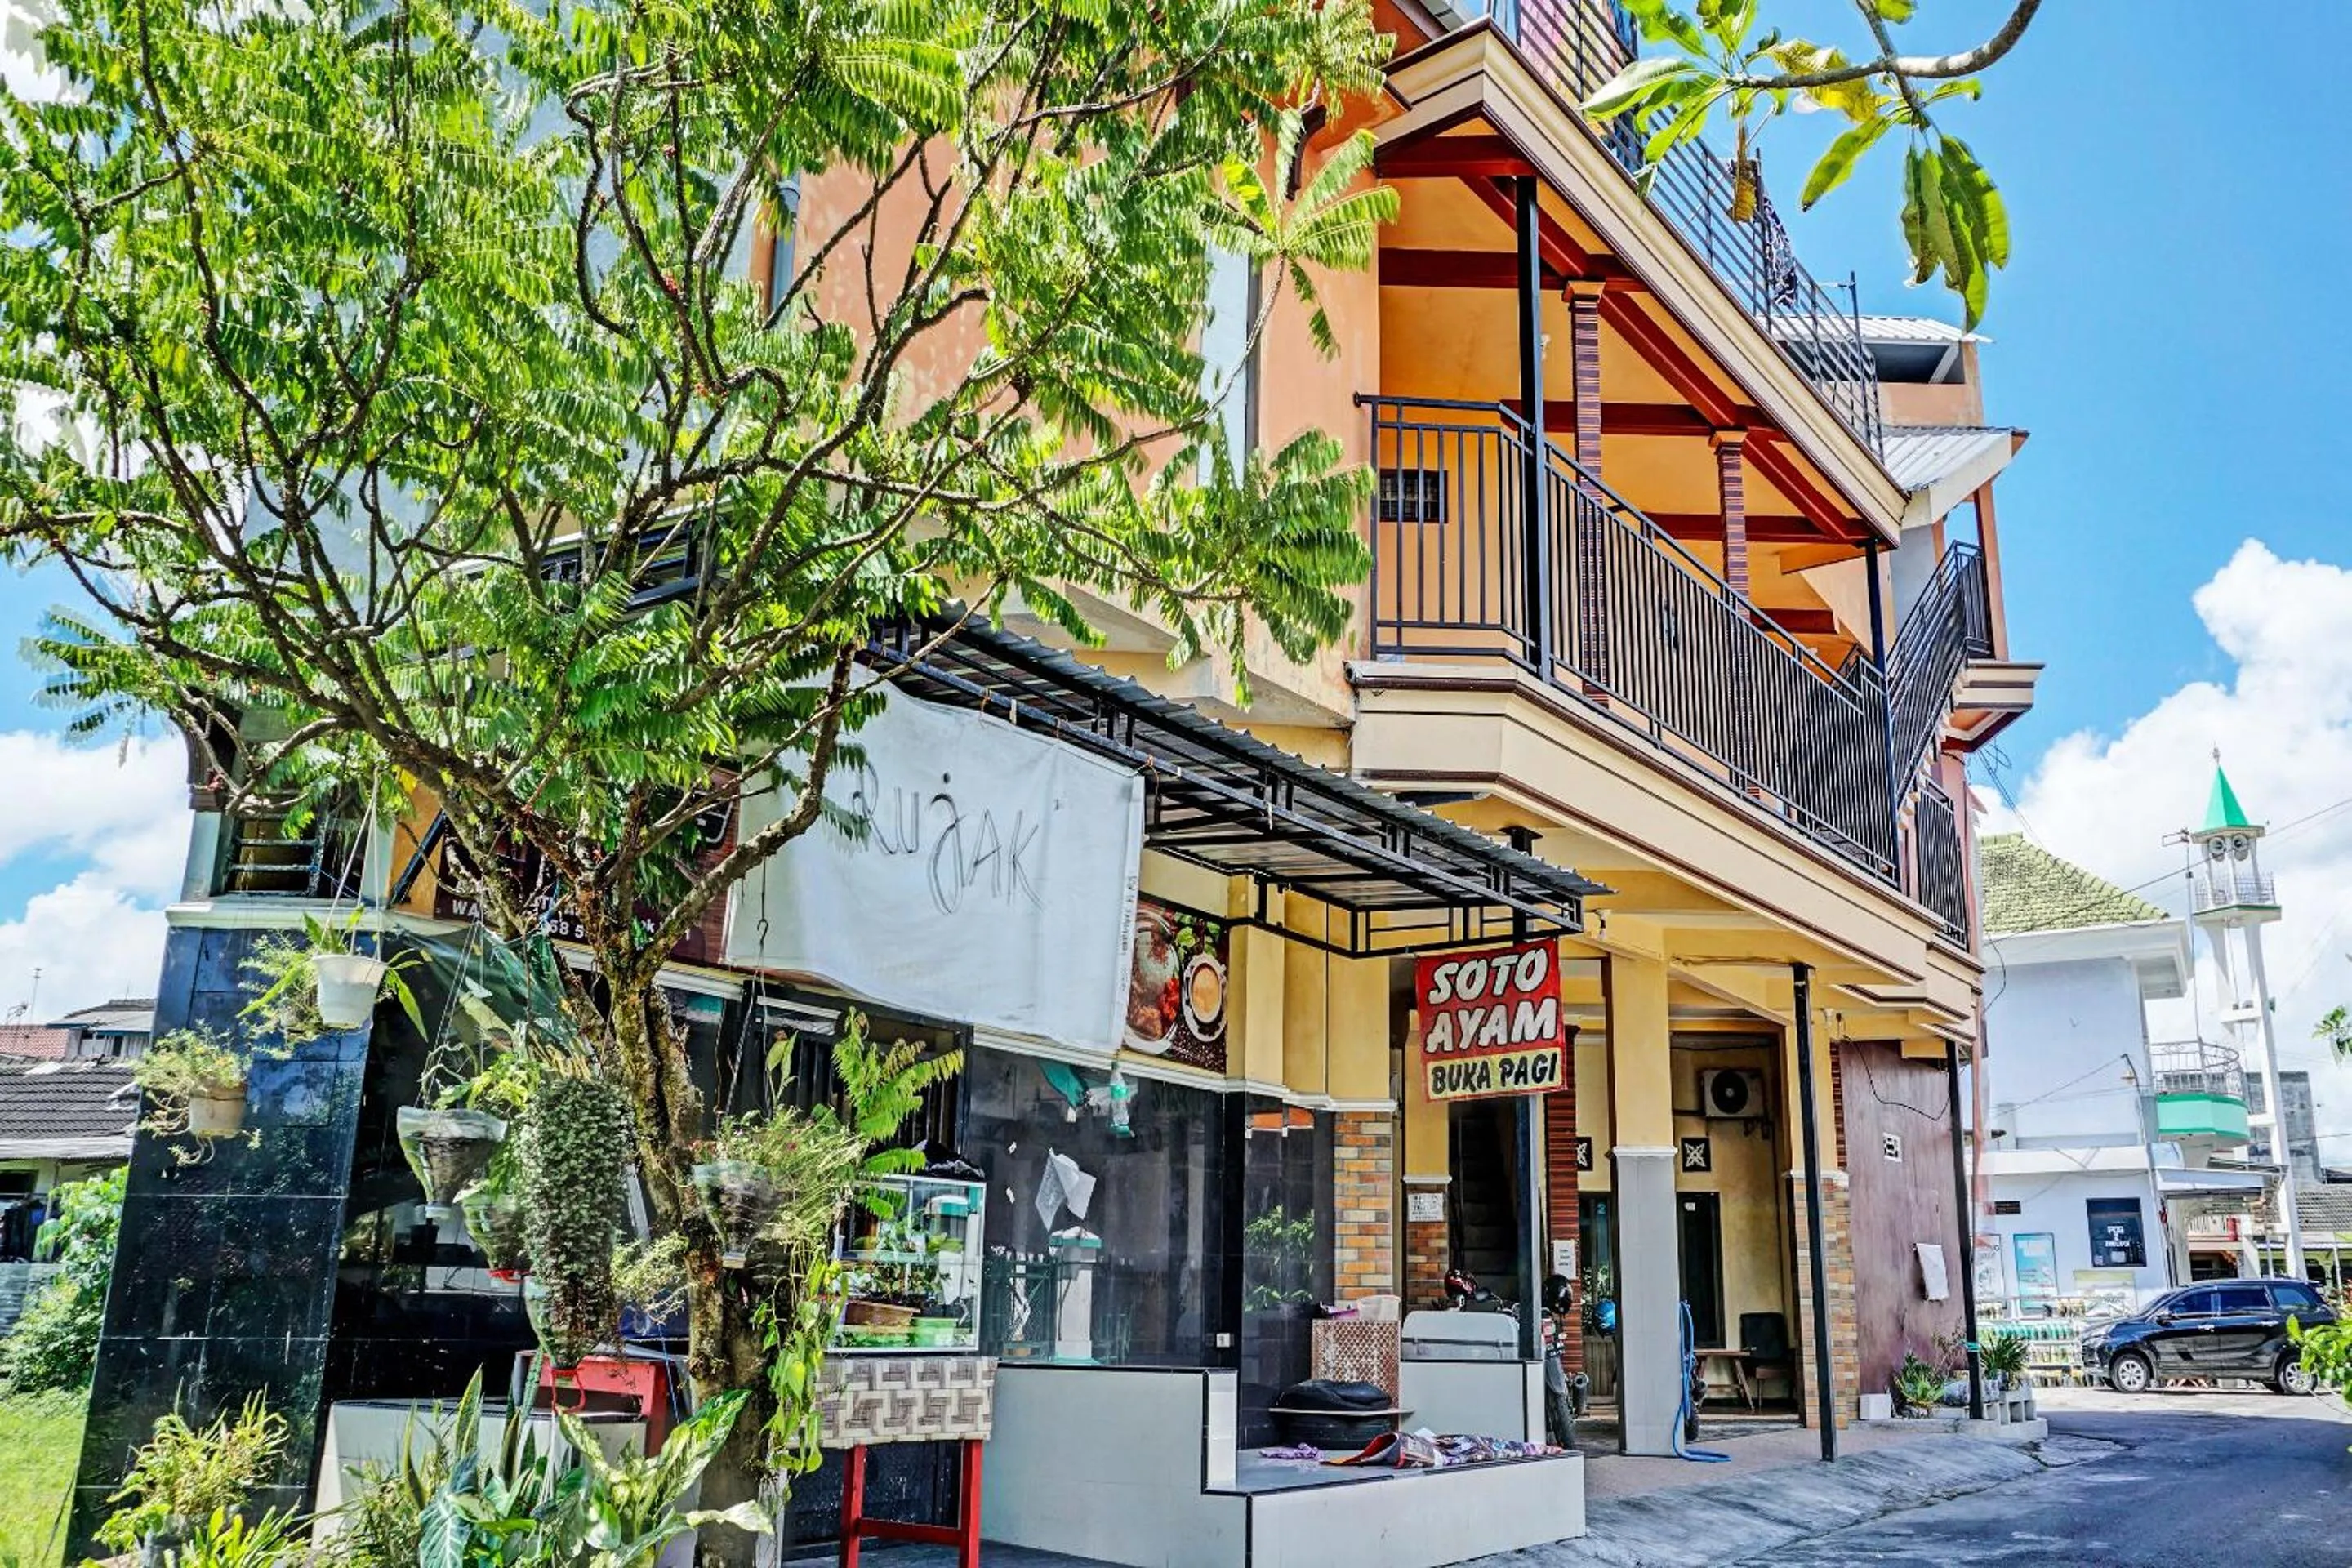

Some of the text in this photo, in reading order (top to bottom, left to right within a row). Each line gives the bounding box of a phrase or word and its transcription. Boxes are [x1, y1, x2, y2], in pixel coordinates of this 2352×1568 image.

[1429, 948, 1548, 1004] SOTO
[1425, 997, 1557, 1054] AYAM
[1431, 1053, 1558, 1094] BUKA PAGI
